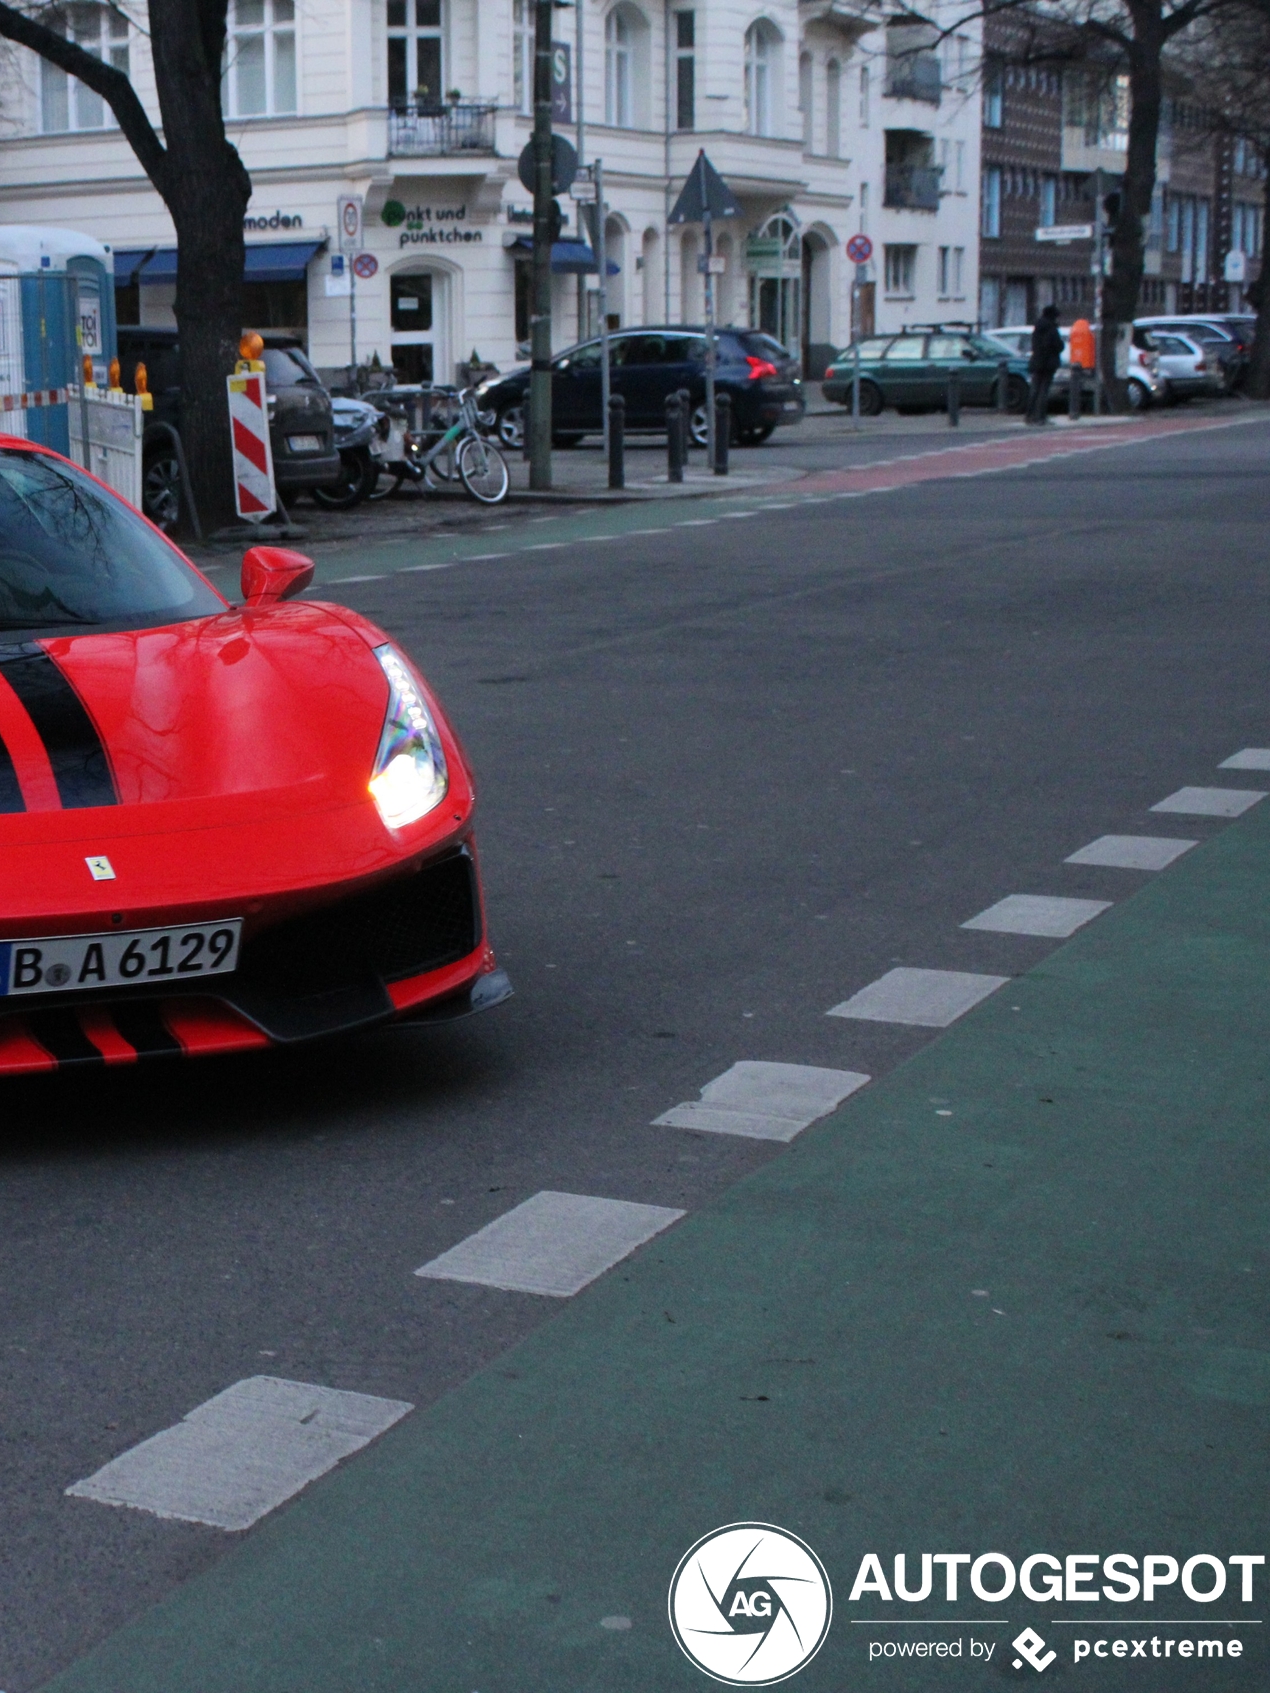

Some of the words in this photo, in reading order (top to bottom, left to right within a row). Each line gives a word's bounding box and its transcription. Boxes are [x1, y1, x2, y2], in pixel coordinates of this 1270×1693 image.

[553, 49, 566, 84] S
[435, 205, 466, 221] und
[13, 948, 43, 989] B
[77, 943, 106, 984] A
[118, 928, 235, 979] 6129
